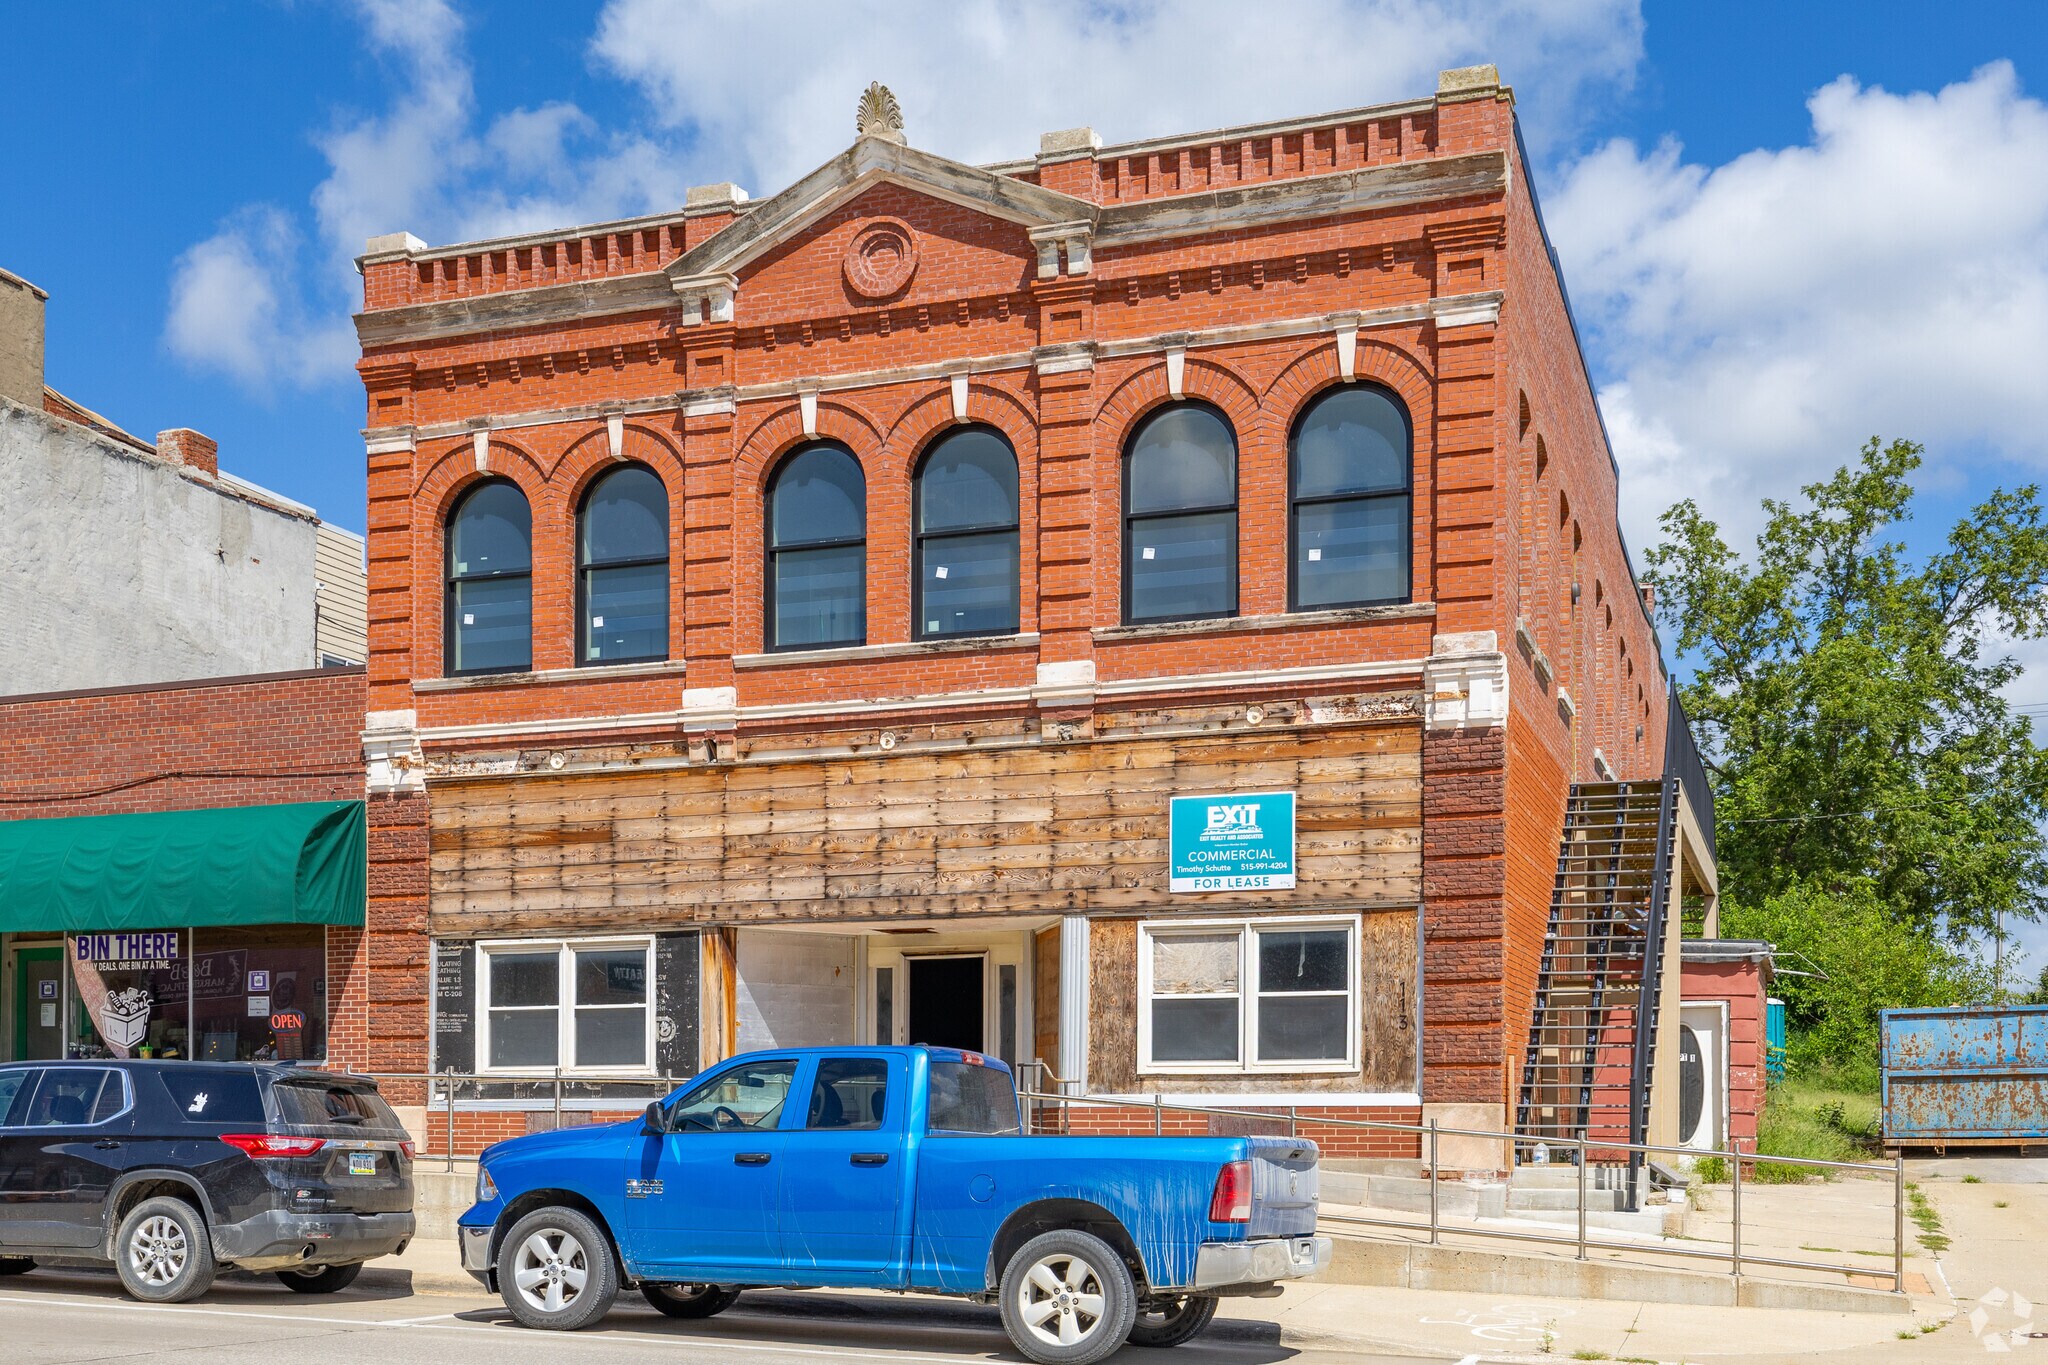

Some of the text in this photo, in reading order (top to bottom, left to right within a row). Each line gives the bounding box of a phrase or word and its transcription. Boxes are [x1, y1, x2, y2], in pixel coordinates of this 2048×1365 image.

[1188, 849, 1276, 862] COMMERCIAL
[1177, 862, 1288, 873] Timothy Schutte 515-991-4204
[1194, 878, 1221, 888] FOR
[1228, 877, 1270, 888] LEASE
[77, 933, 177, 960] BIN THERE
[82, 960, 170, 971] DAILY DEALS. ONE BIN AT A TIME.
[271, 1014, 302, 1029] OPEN
[626, 1178, 664, 1187] RAM
[626, 1186, 664, 1195] 1500
